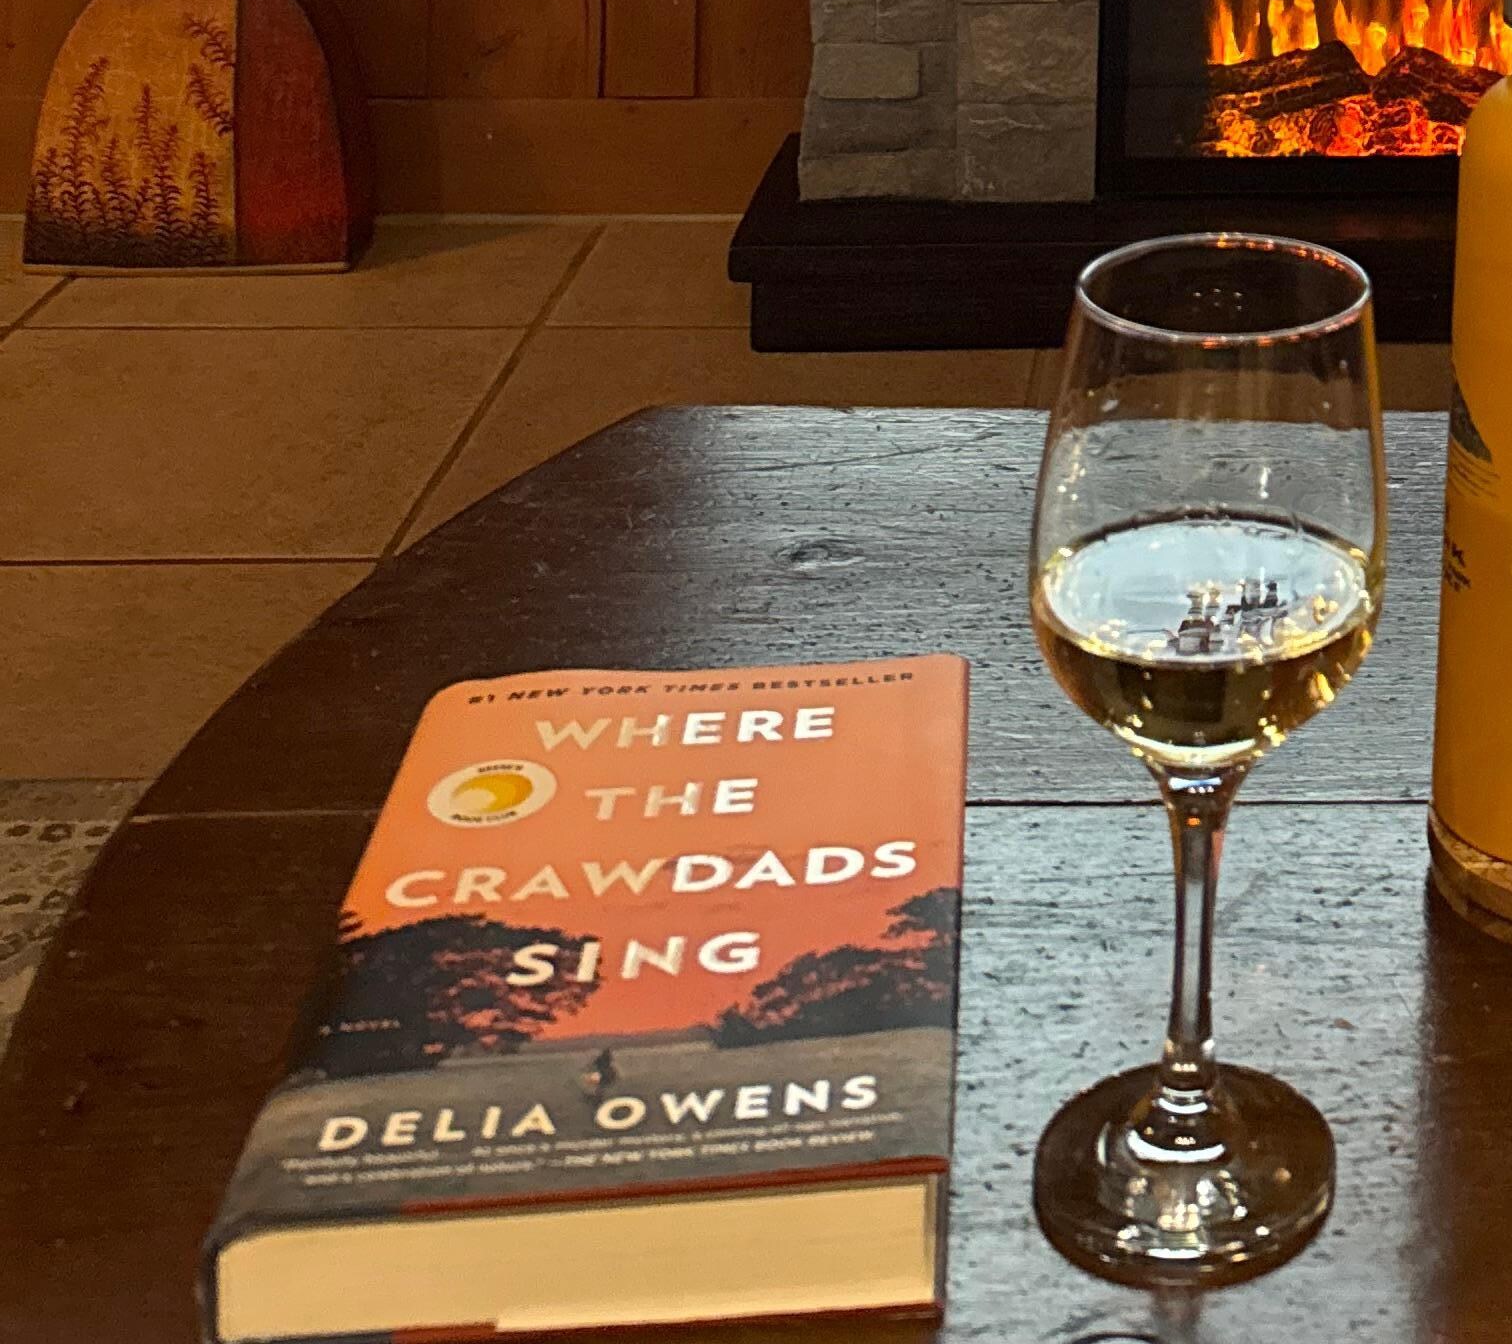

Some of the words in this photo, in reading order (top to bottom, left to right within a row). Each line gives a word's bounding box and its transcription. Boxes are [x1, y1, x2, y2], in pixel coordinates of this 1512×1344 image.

[507, 687, 569, 702] NEW
[582, 684, 652, 696] YORK
[665, 681, 740, 693] TIMES
[753, 672, 915, 691] BESTSELLER
[535, 706, 836, 752] WHERE
[585, 778, 759, 821] THE
[384, 841, 917, 909] CRAWDADS
[506, 931, 761, 987] SING
[318, 1102, 557, 1152] DELIA
[595, 1075, 878, 1130] OWENS
